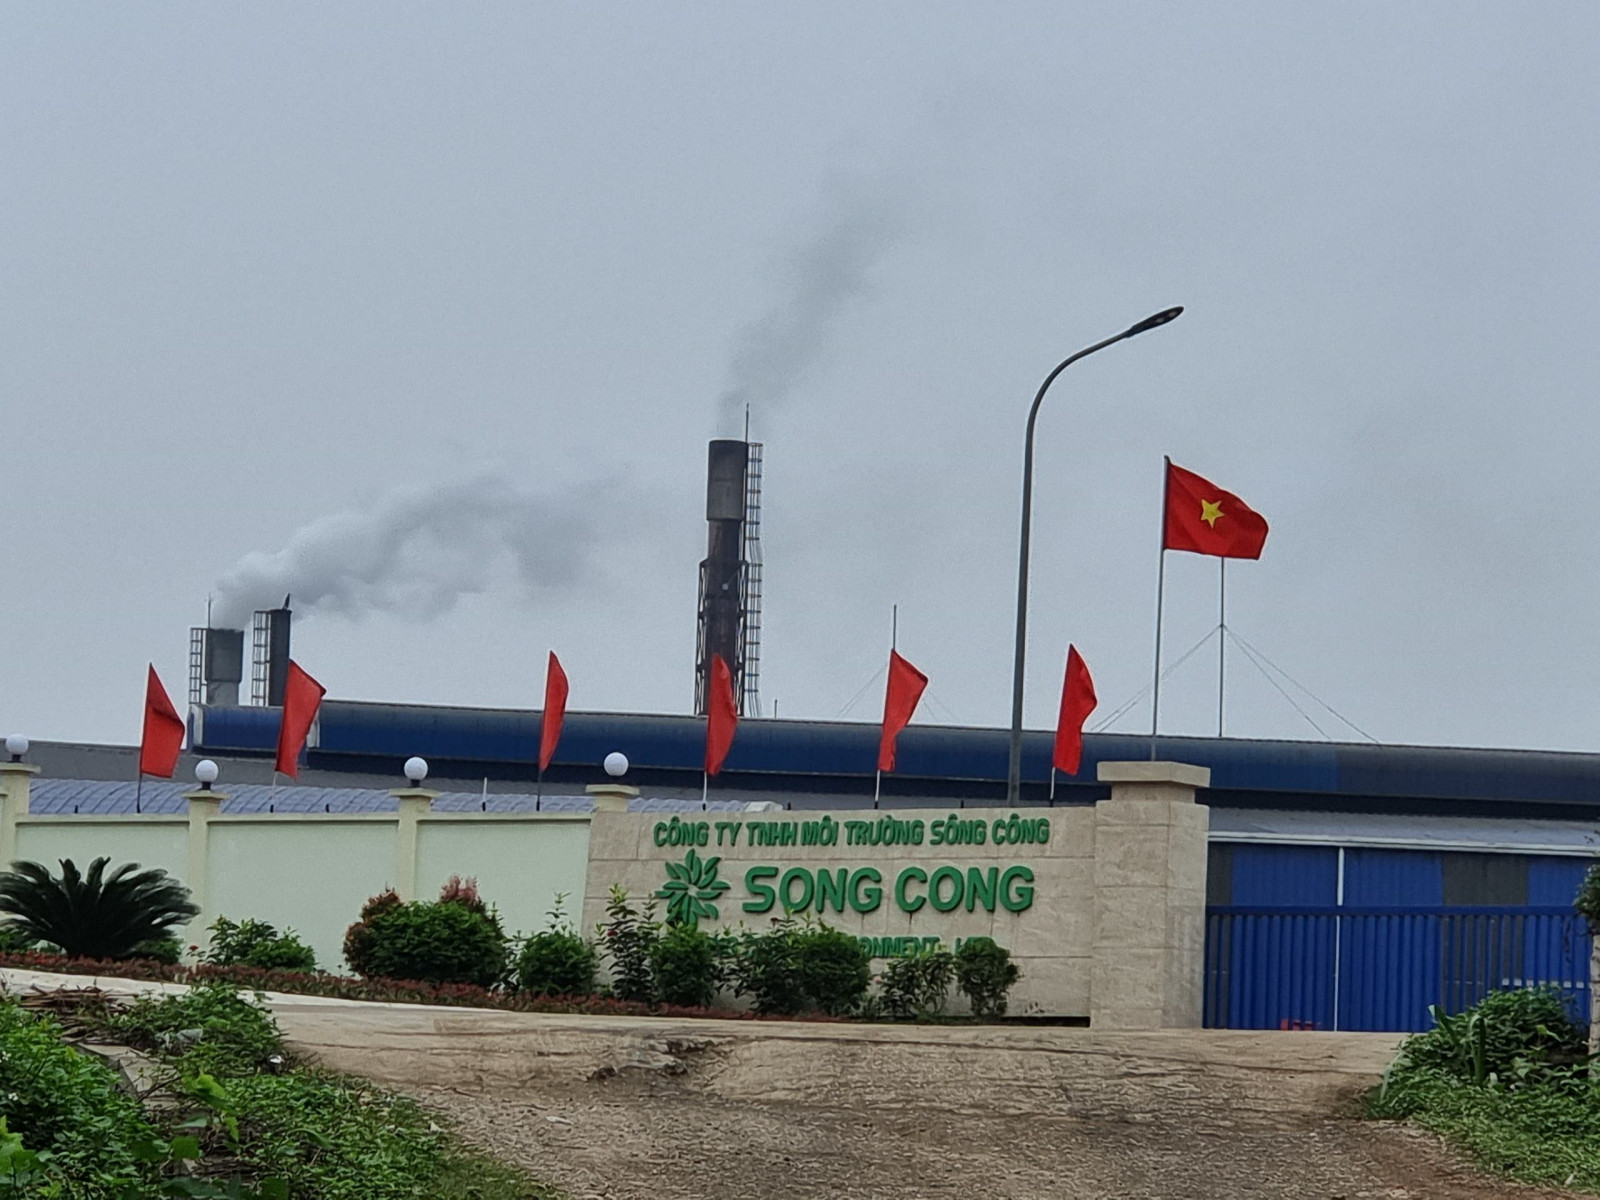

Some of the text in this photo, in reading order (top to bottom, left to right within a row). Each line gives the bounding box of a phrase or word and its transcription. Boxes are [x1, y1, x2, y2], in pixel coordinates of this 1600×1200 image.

[653, 813, 1050, 847] CÔNG TY TNHH MÔI TRƯỜNG SÔNG CÔNG
[742, 865, 1035, 913] SONG CONG
